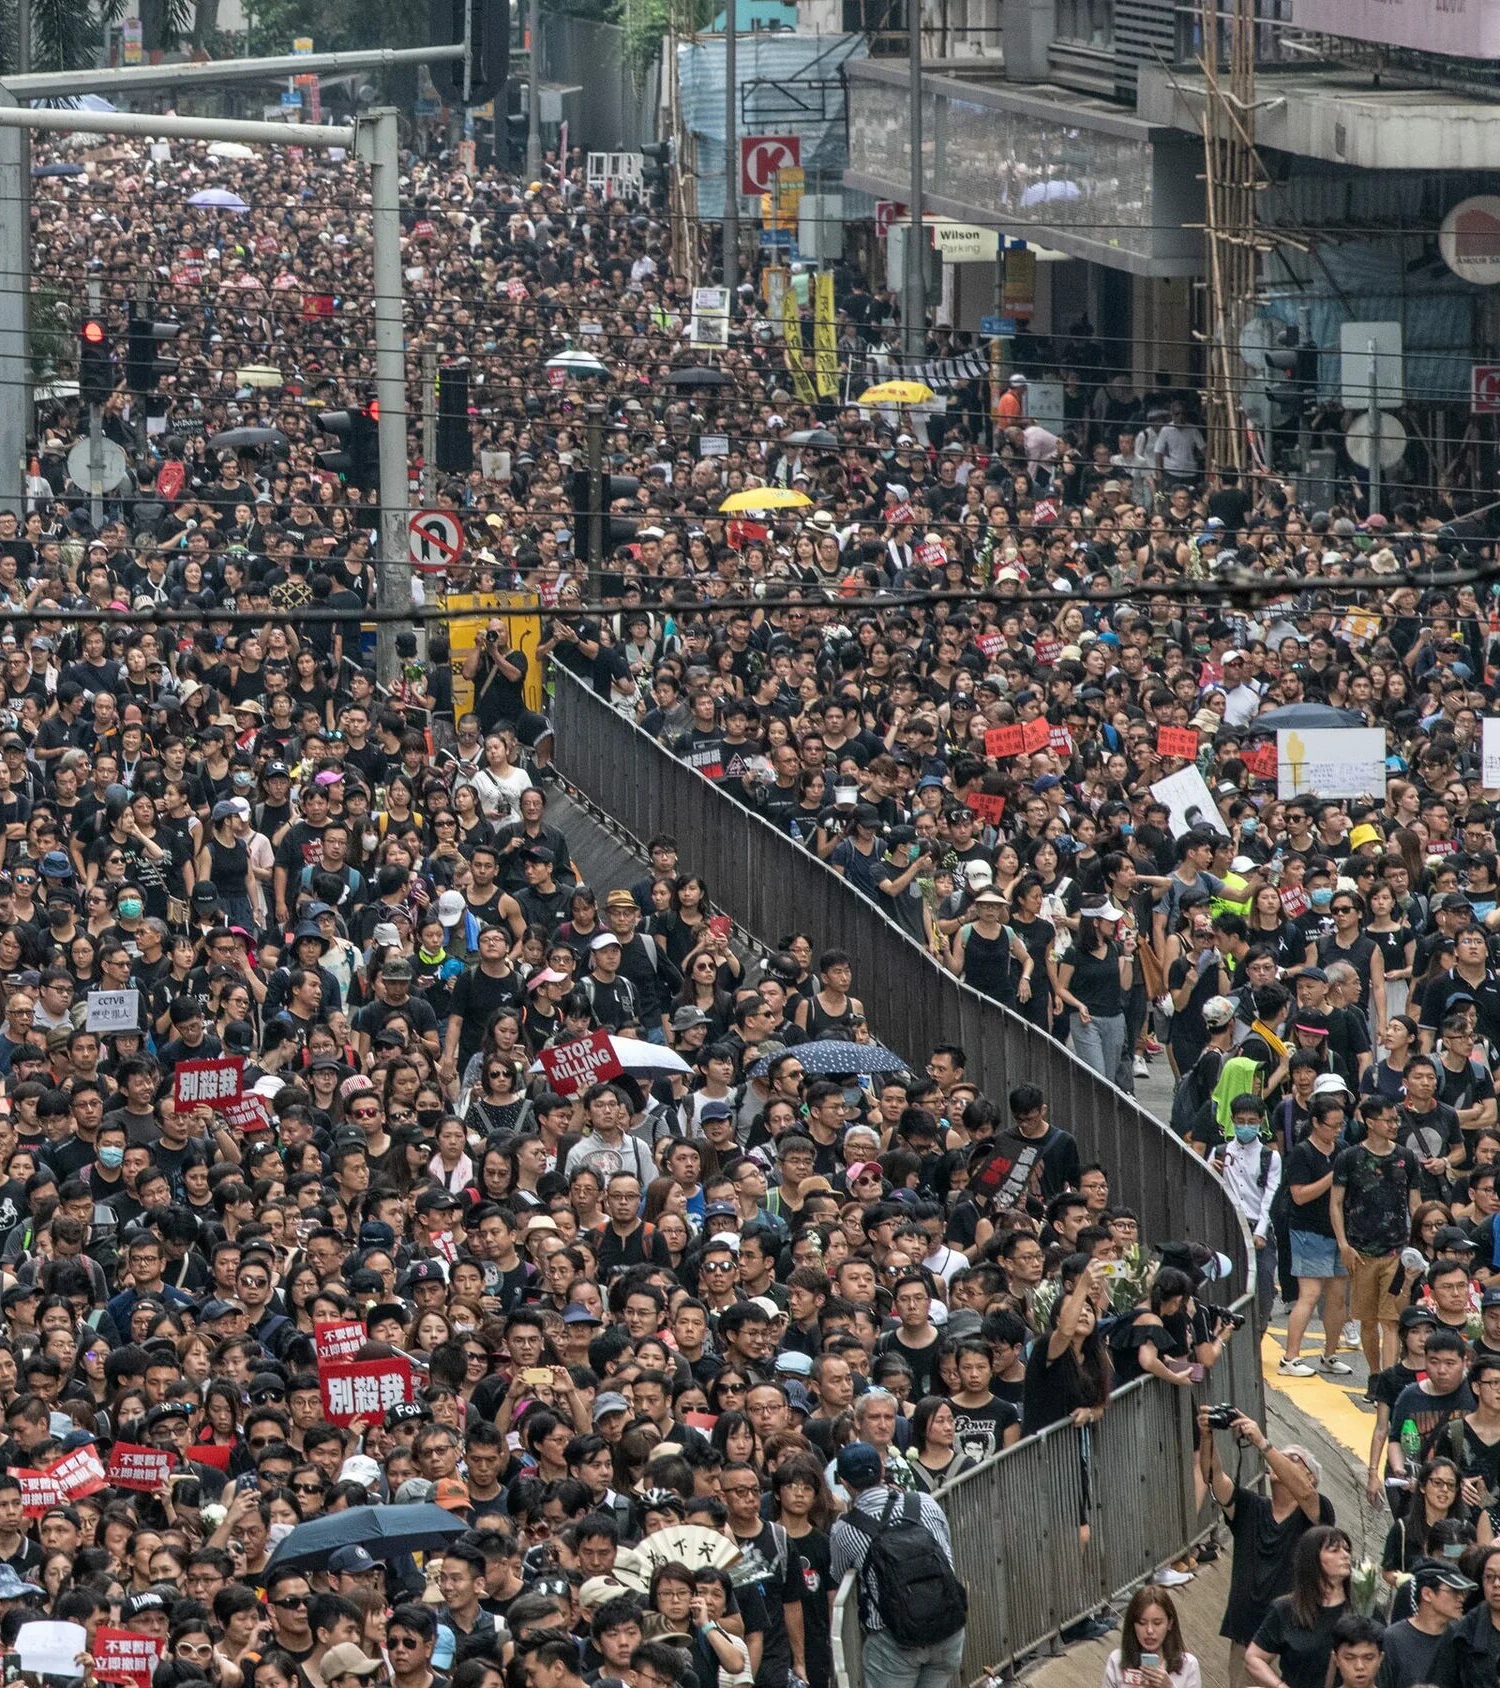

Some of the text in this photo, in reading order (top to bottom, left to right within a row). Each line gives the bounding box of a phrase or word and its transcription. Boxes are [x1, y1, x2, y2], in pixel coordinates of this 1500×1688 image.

[940, 231, 980, 240] Wilson
[941, 243, 980, 255] Parking
[98, 996, 124, 1005] CCTVB
[554, 1038, 593, 1063] STOP
[550, 1048, 612, 1081] KILLING
[179, 1067, 238, 1102] 別殺我
[574, 1071, 598, 1087] US
[323, 1324, 363, 1342] 不要暫緩
[318, 1339, 361, 1358] 立即撤回
[327, 1373, 405, 1415] 別殺我
[954, 1415, 996, 1432] BOWIE
[120, 1453, 168, 1468] 不要暫緩
[108, 1466, 158, 1483] 立即撤回
[21, 1492, 56, 1505] 即撤回
[105, 1640, 157, 1655] 不要暫緩
[94, 1656, 147, 1671] 立即撤回
